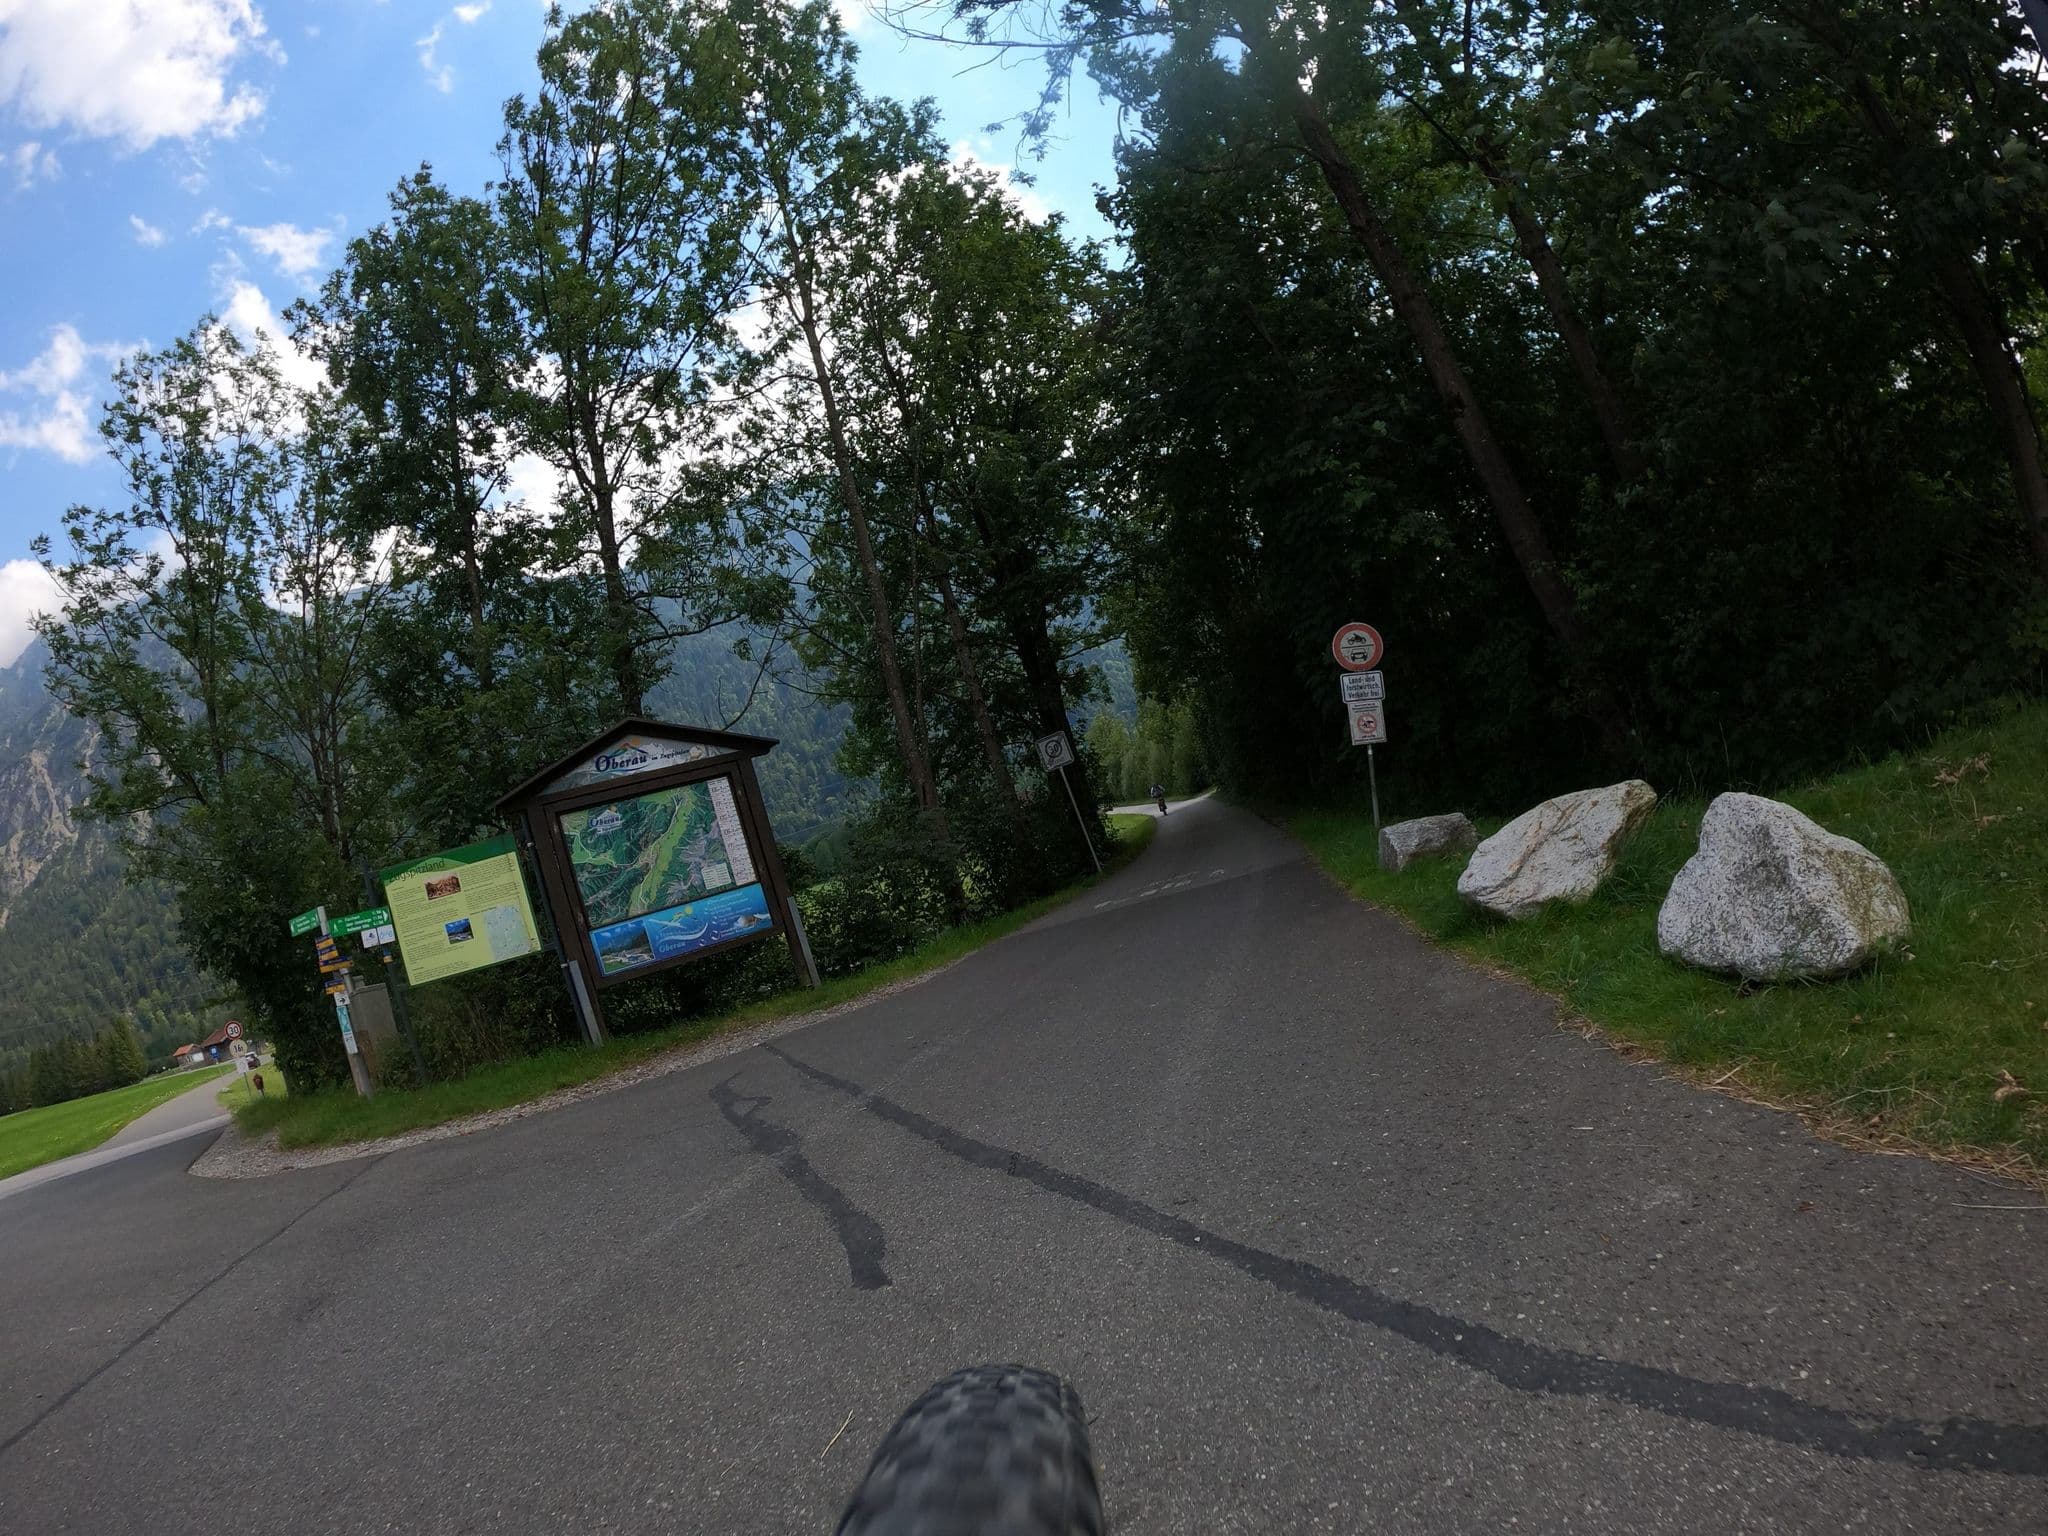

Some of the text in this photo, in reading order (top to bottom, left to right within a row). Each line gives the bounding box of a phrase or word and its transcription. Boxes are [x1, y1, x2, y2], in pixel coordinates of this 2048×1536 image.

[595, 754, 648, 772] Oberau
[389, 857, 445, 883] Zugspitzland
[229, 1026, 239, 1035] 30
